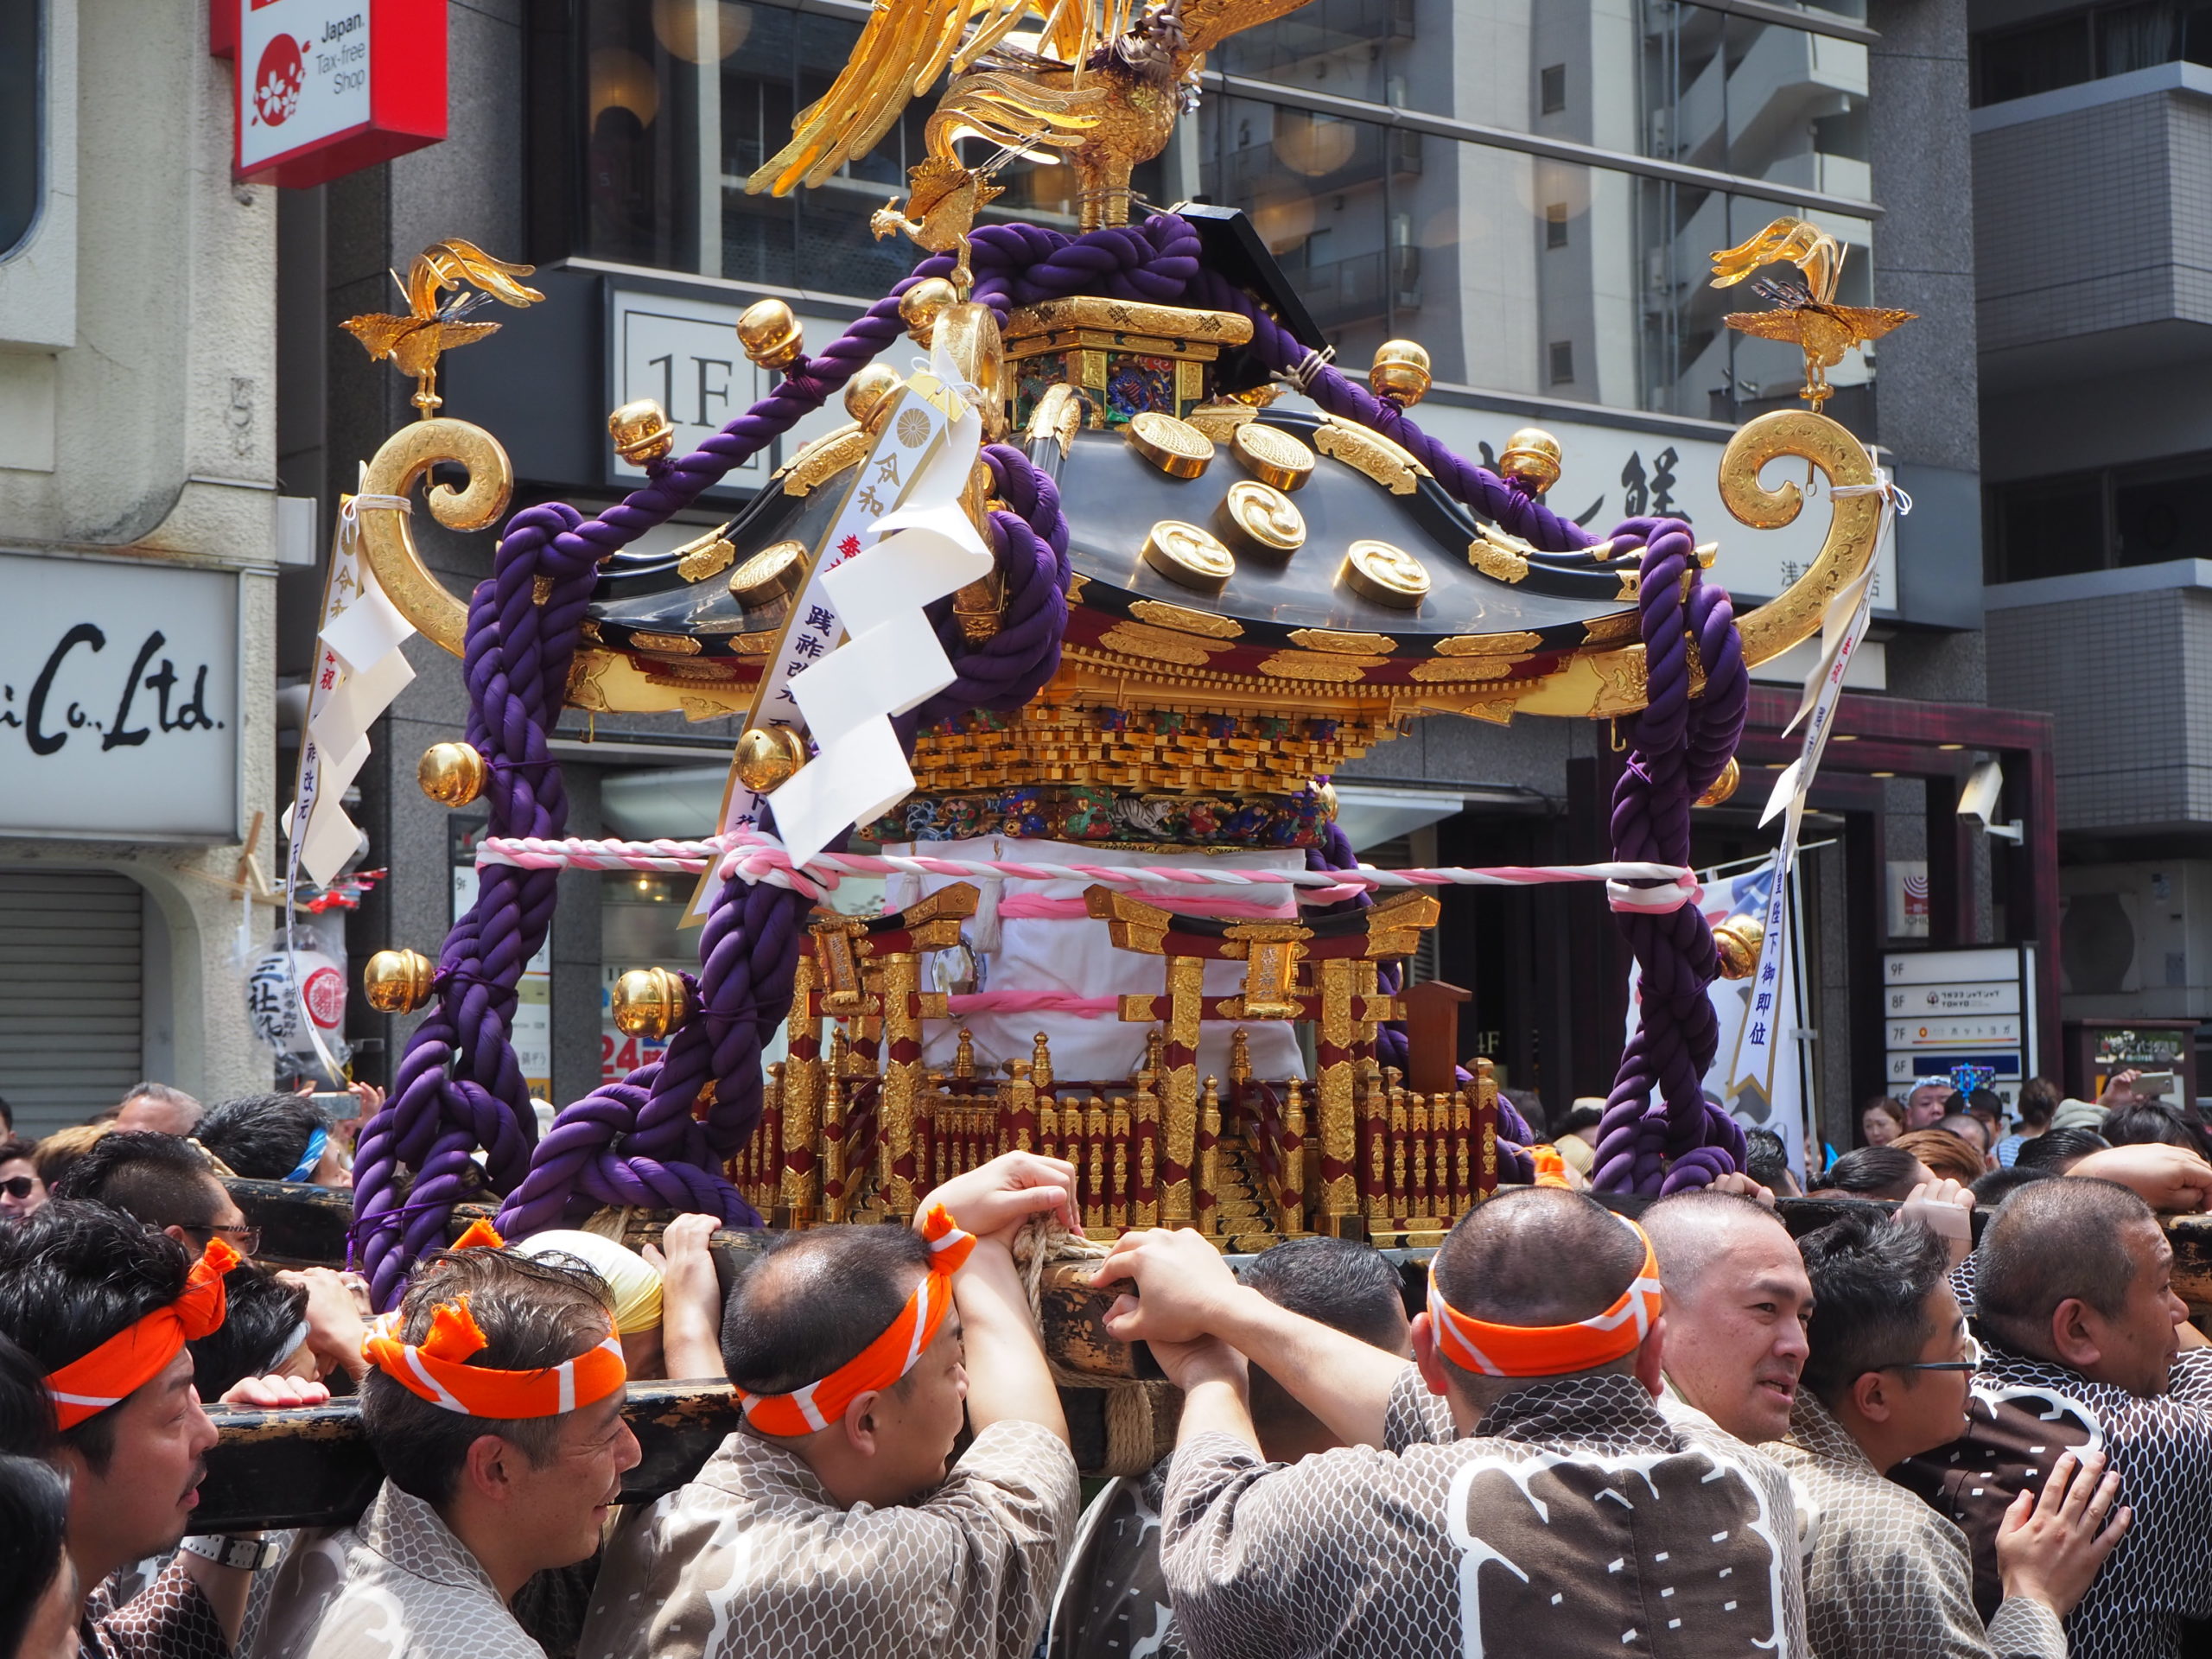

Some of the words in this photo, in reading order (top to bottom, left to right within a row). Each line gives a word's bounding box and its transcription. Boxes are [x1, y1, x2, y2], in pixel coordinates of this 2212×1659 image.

[315, 41, 365, 76] Tax-free
[334, 67, 365, 95] Shop
[649, 353, 733, 428] 1F
[857, 452, 901, 518] 令和
[102, 630, 225, 752] Ltd.
[1891, 963, 1904, 976] 9F
[1891, 995, 1905, 1009] 8F
[1893, 1027, 1906, 1041] 7F
[1893, 1059, 1906, 1073] 6F
